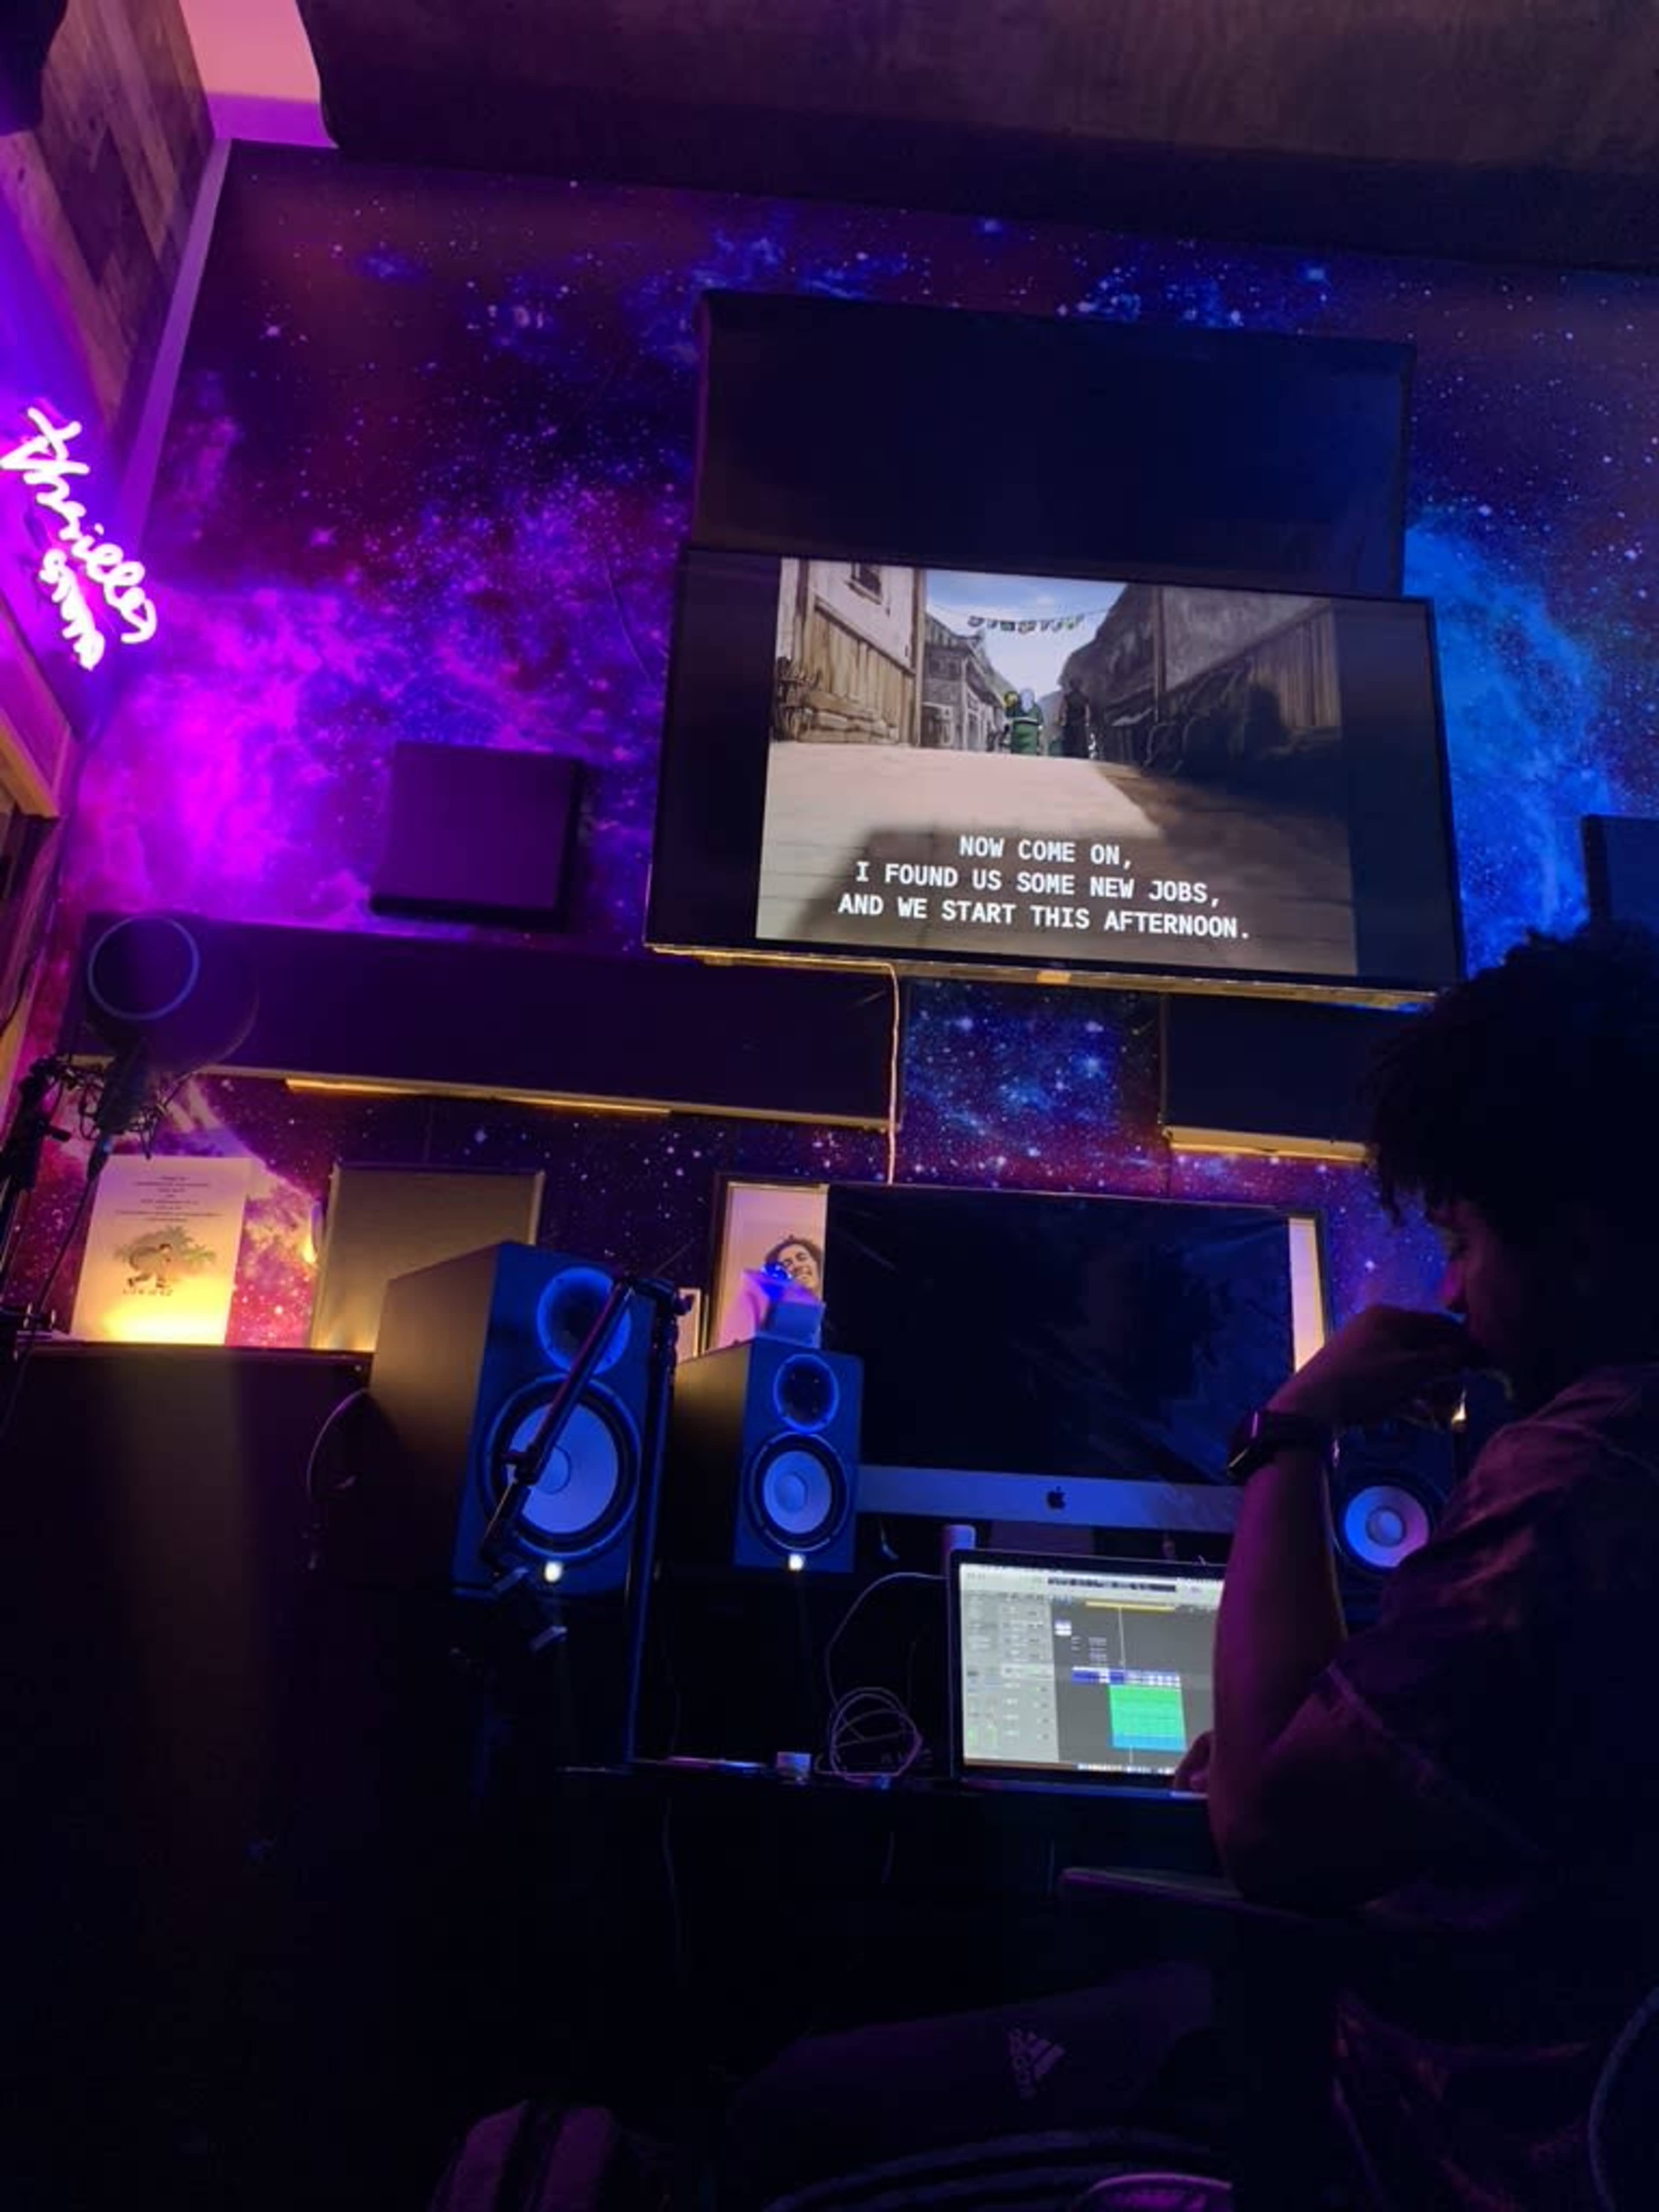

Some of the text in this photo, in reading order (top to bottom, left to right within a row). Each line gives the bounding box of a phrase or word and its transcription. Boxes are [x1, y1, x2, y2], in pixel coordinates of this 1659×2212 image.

[959, 835, 1131, 870] NOW COME ON,
[856, 861, 1219, 908] I FOUND US SOME NEW JOBS,
[838, 893, 1249, 939] AND WE START THIS AFTERNOON.
